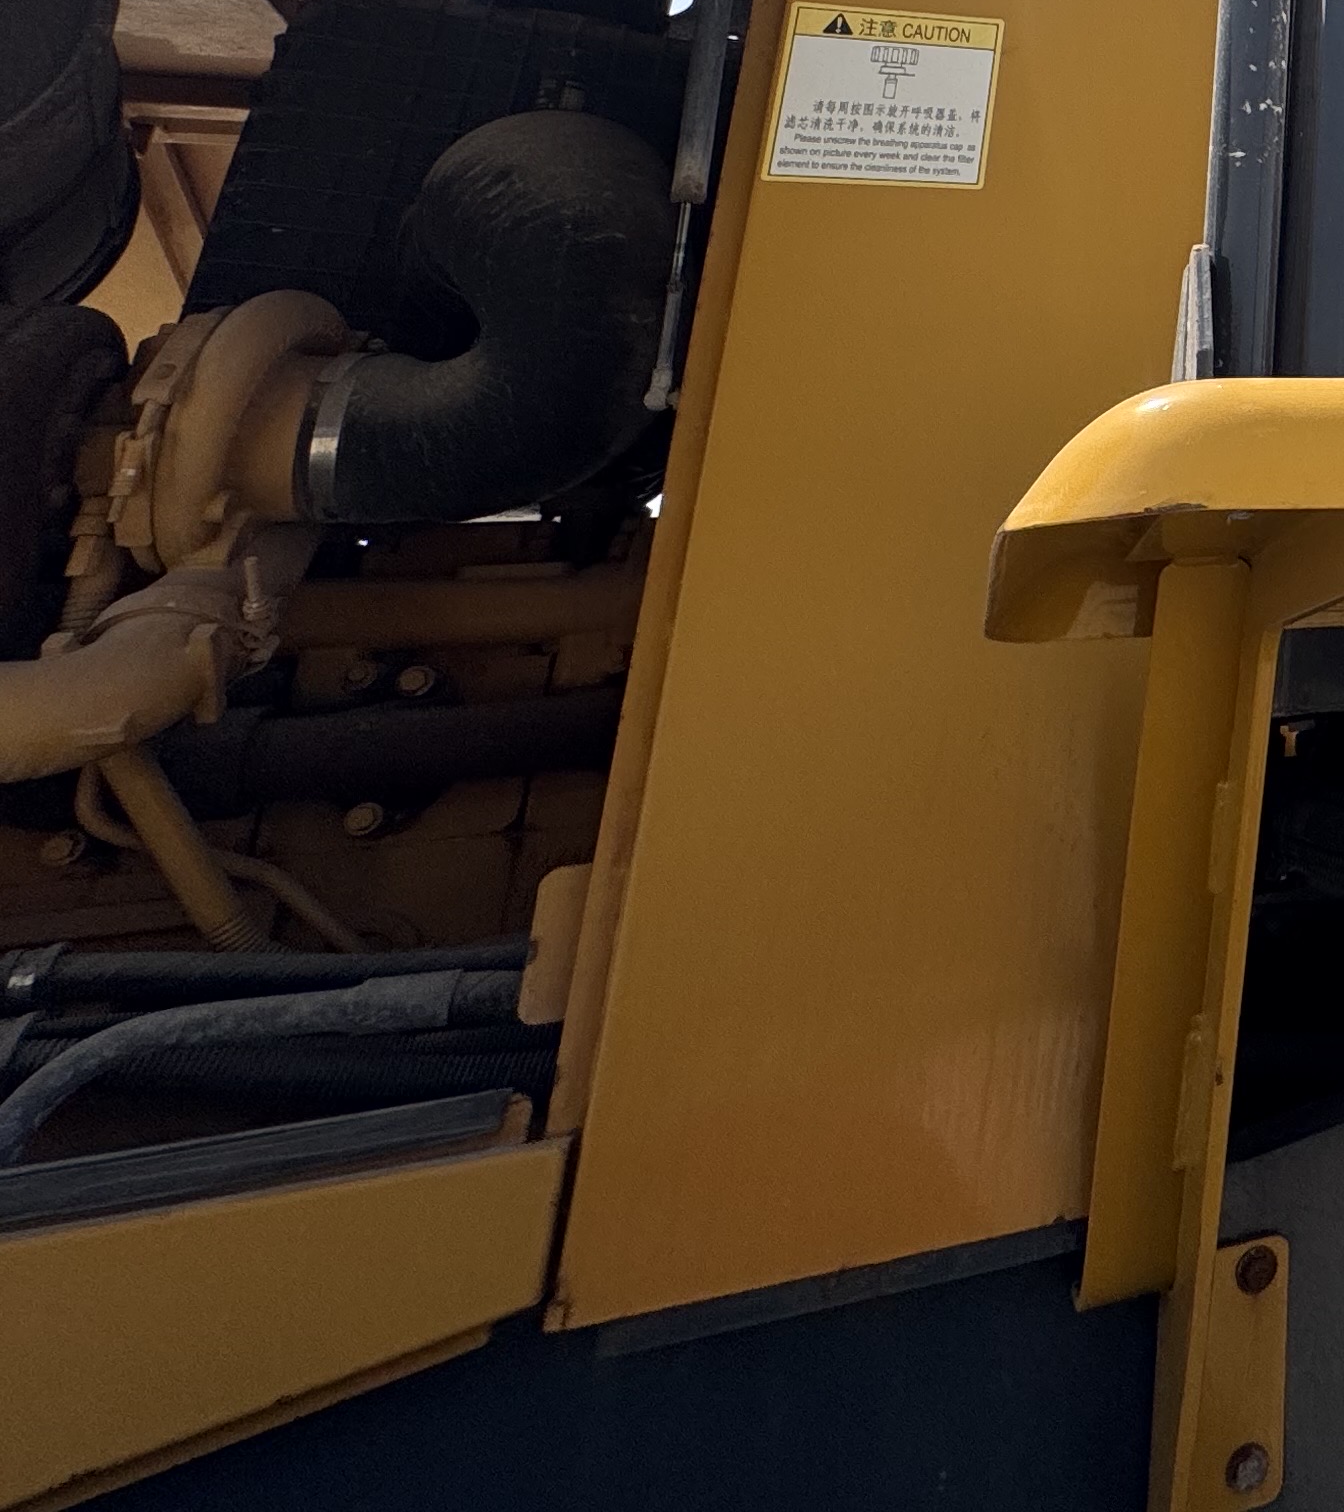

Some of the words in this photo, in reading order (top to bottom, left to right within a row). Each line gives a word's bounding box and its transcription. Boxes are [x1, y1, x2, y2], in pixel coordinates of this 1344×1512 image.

[859, 17, 897, 38] 注意
[902, 23, 971, 44] CAUTION
[793, 133, 822, 144] Please
[858, 136, 871, 146] the
[949, 144, 964, 153] cap
[779, 146, 808, 155] shown
[823, 148, 852, 158] picture
[853, 151, 877, 161] every
[879, 151, 900, 160] week
[902, 152, 919, 162] and
[942, 154, 956, 163] the
[957, 155, 975, 164] filter
[776, 158, 810, 169] element
[811, 160, 820, 170] to
[821, 162, 849, 171] ensure
[850, 162, 863, 172] the
[908, 165, 917, 174] of
[918, 165, 931, 175] the
